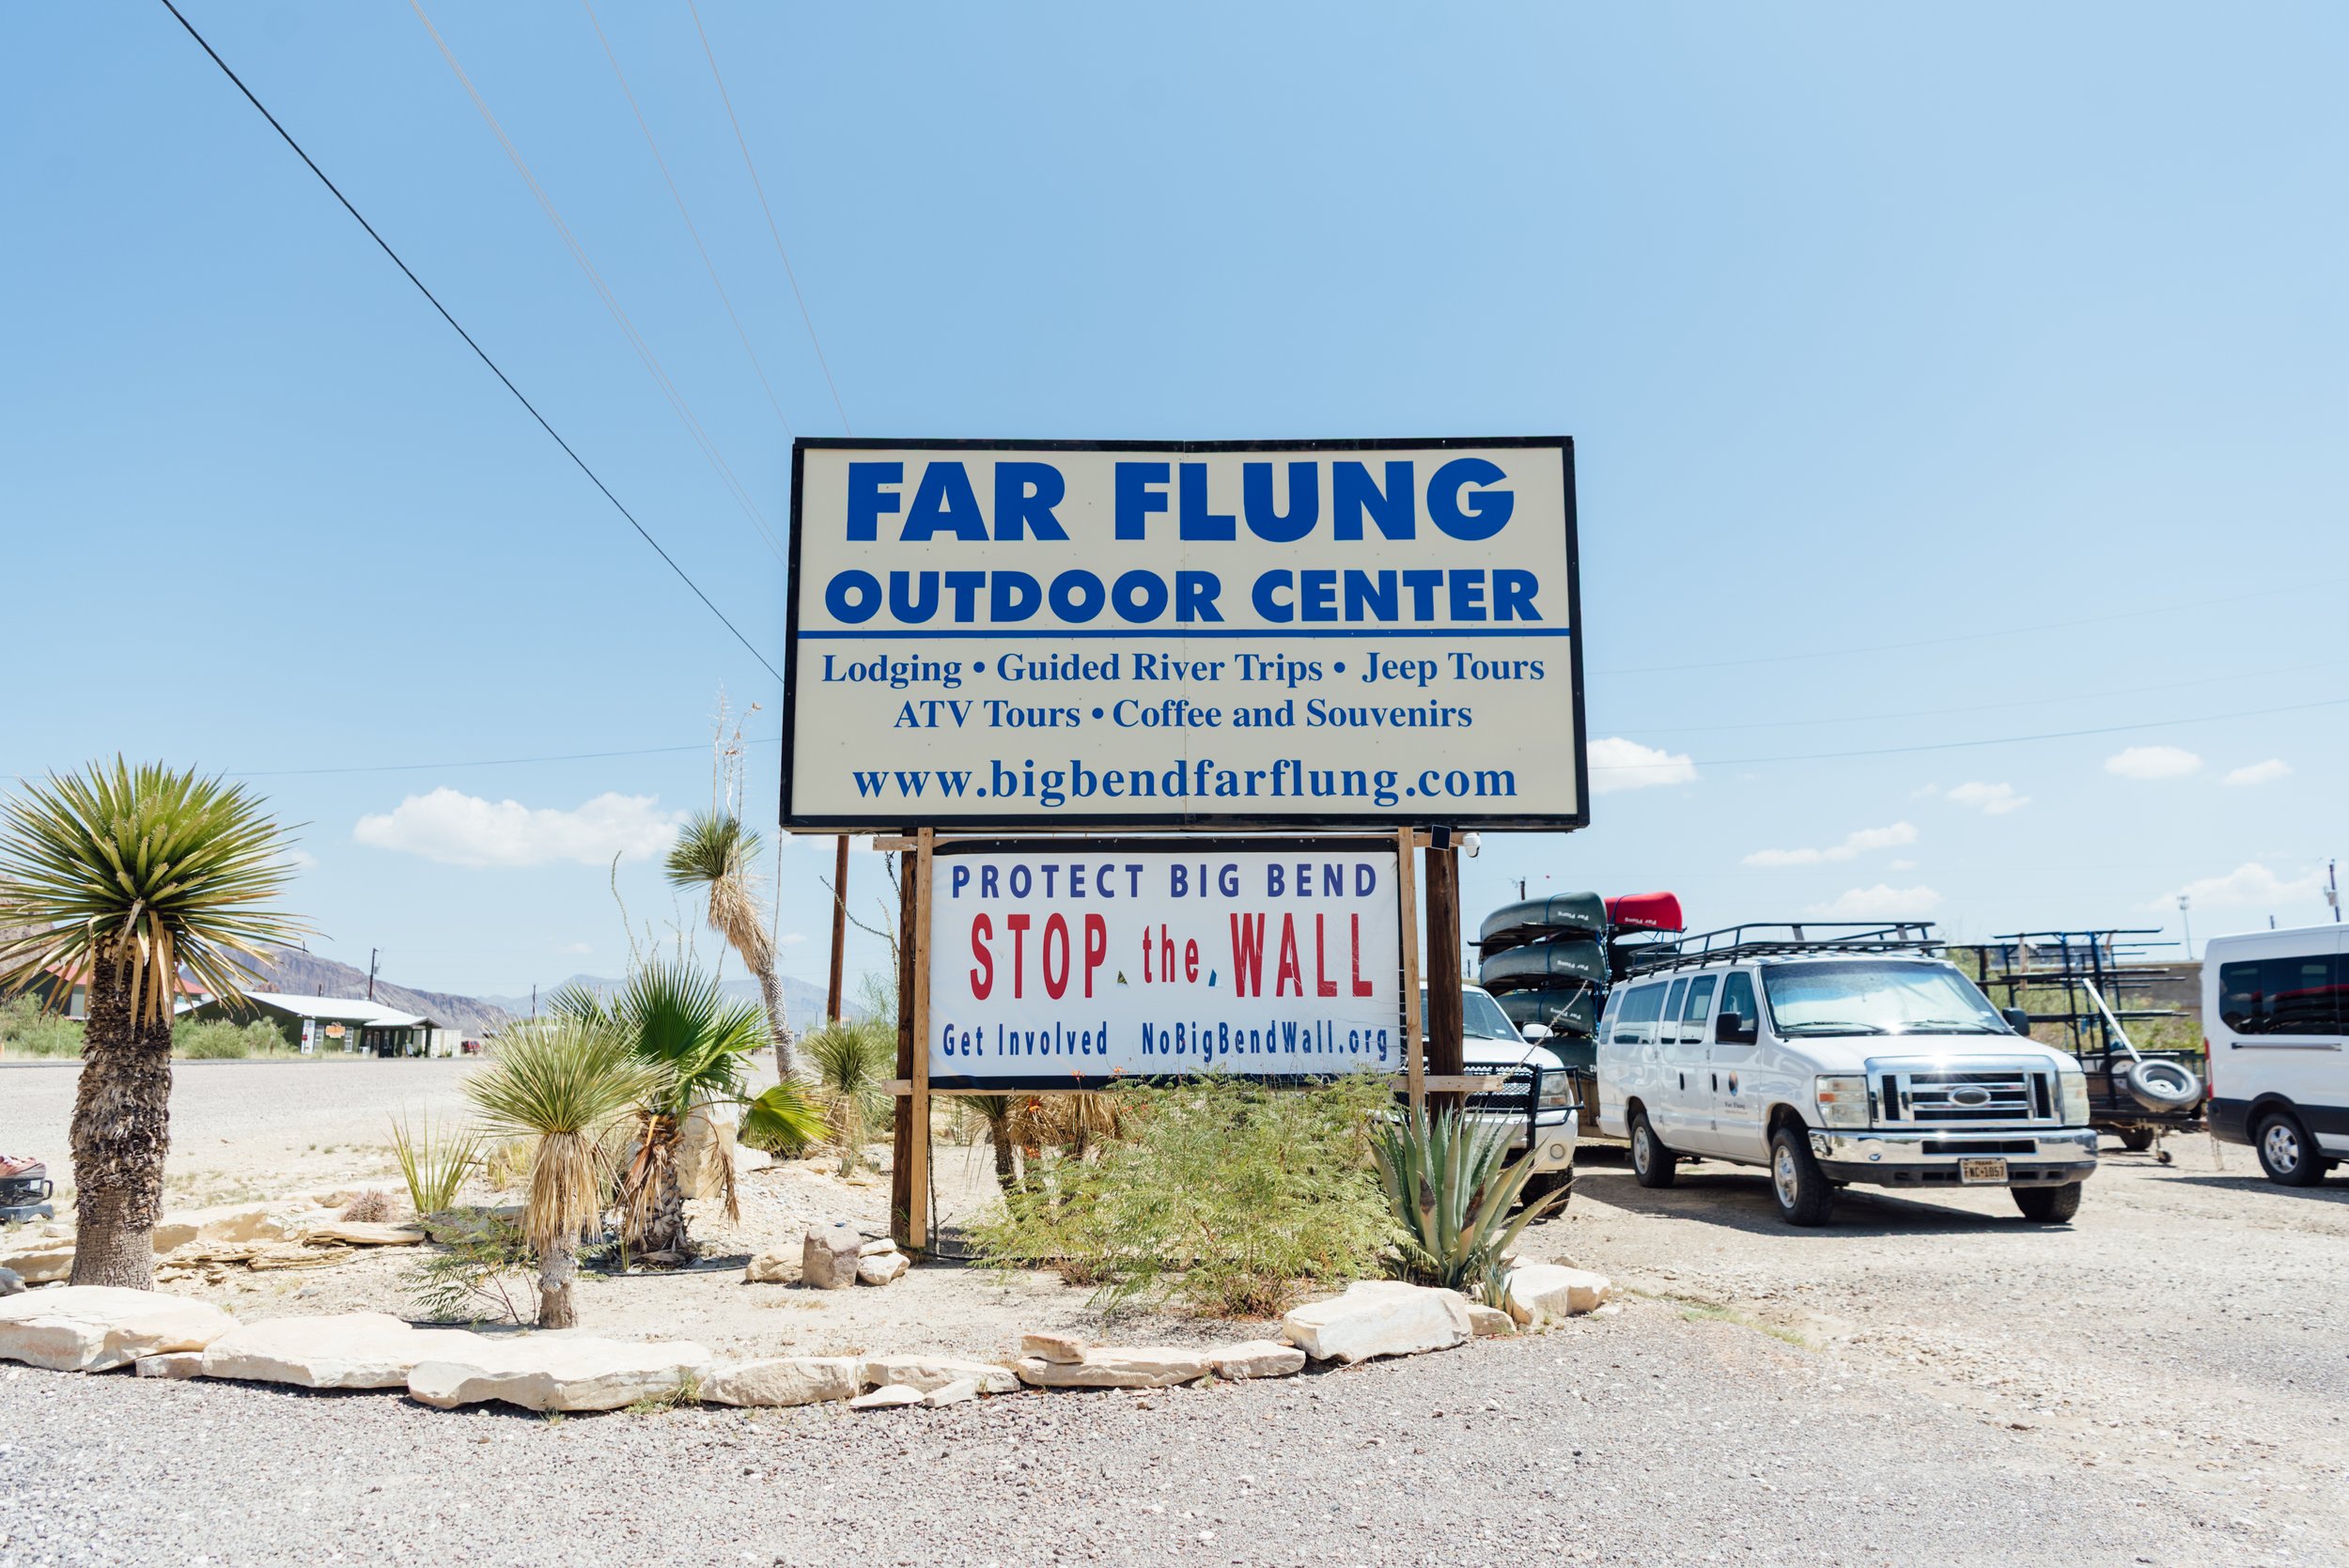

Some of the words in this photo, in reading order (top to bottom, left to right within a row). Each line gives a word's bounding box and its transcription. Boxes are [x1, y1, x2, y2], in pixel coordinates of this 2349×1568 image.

[847, 461, 1070, 541] FAR
[1115, 458, 1514, 542] FLUNG
[825, 569, 1224, 624] OUTDOOR
[1252, 568, 1543, 623] CENTER
[822, 654, 962, 689] Lodging
[997, 653, 1120, 681] Guided
[1132, 653, 1225, 681] River
[1235, 653, 1323, 688] Trips
[1361, 652, 1438, 687] Jeep
[1448, 652, 1545, 680] Tours
[894, 700, 973, 728] ATV
[984, 700, 1081, 727] Tours
[1112, 698, 1221, 727] Coffee
[1233, 699, 1295, 727] and
[1306, 698, 1472, 727] Souvenirs
[852, 759, 1517, 808] www.bigbendfarflung.com
[952, 863, 1143, 898] PROTECT
[1171, 863, 1239, 897] BIG
[1268, 862, 1377, 897] BEND
[970, 912, 1107, 1001] STOP
[1143, 924, 1199, 984] the
[1230, 912, 1373, 998] WALL
[943, 1023, 984, 1056] Get
[999, 1021, 1107, 1055] Involved
[1142, 1019, 1388, 1063] NoBigBendWall.org
